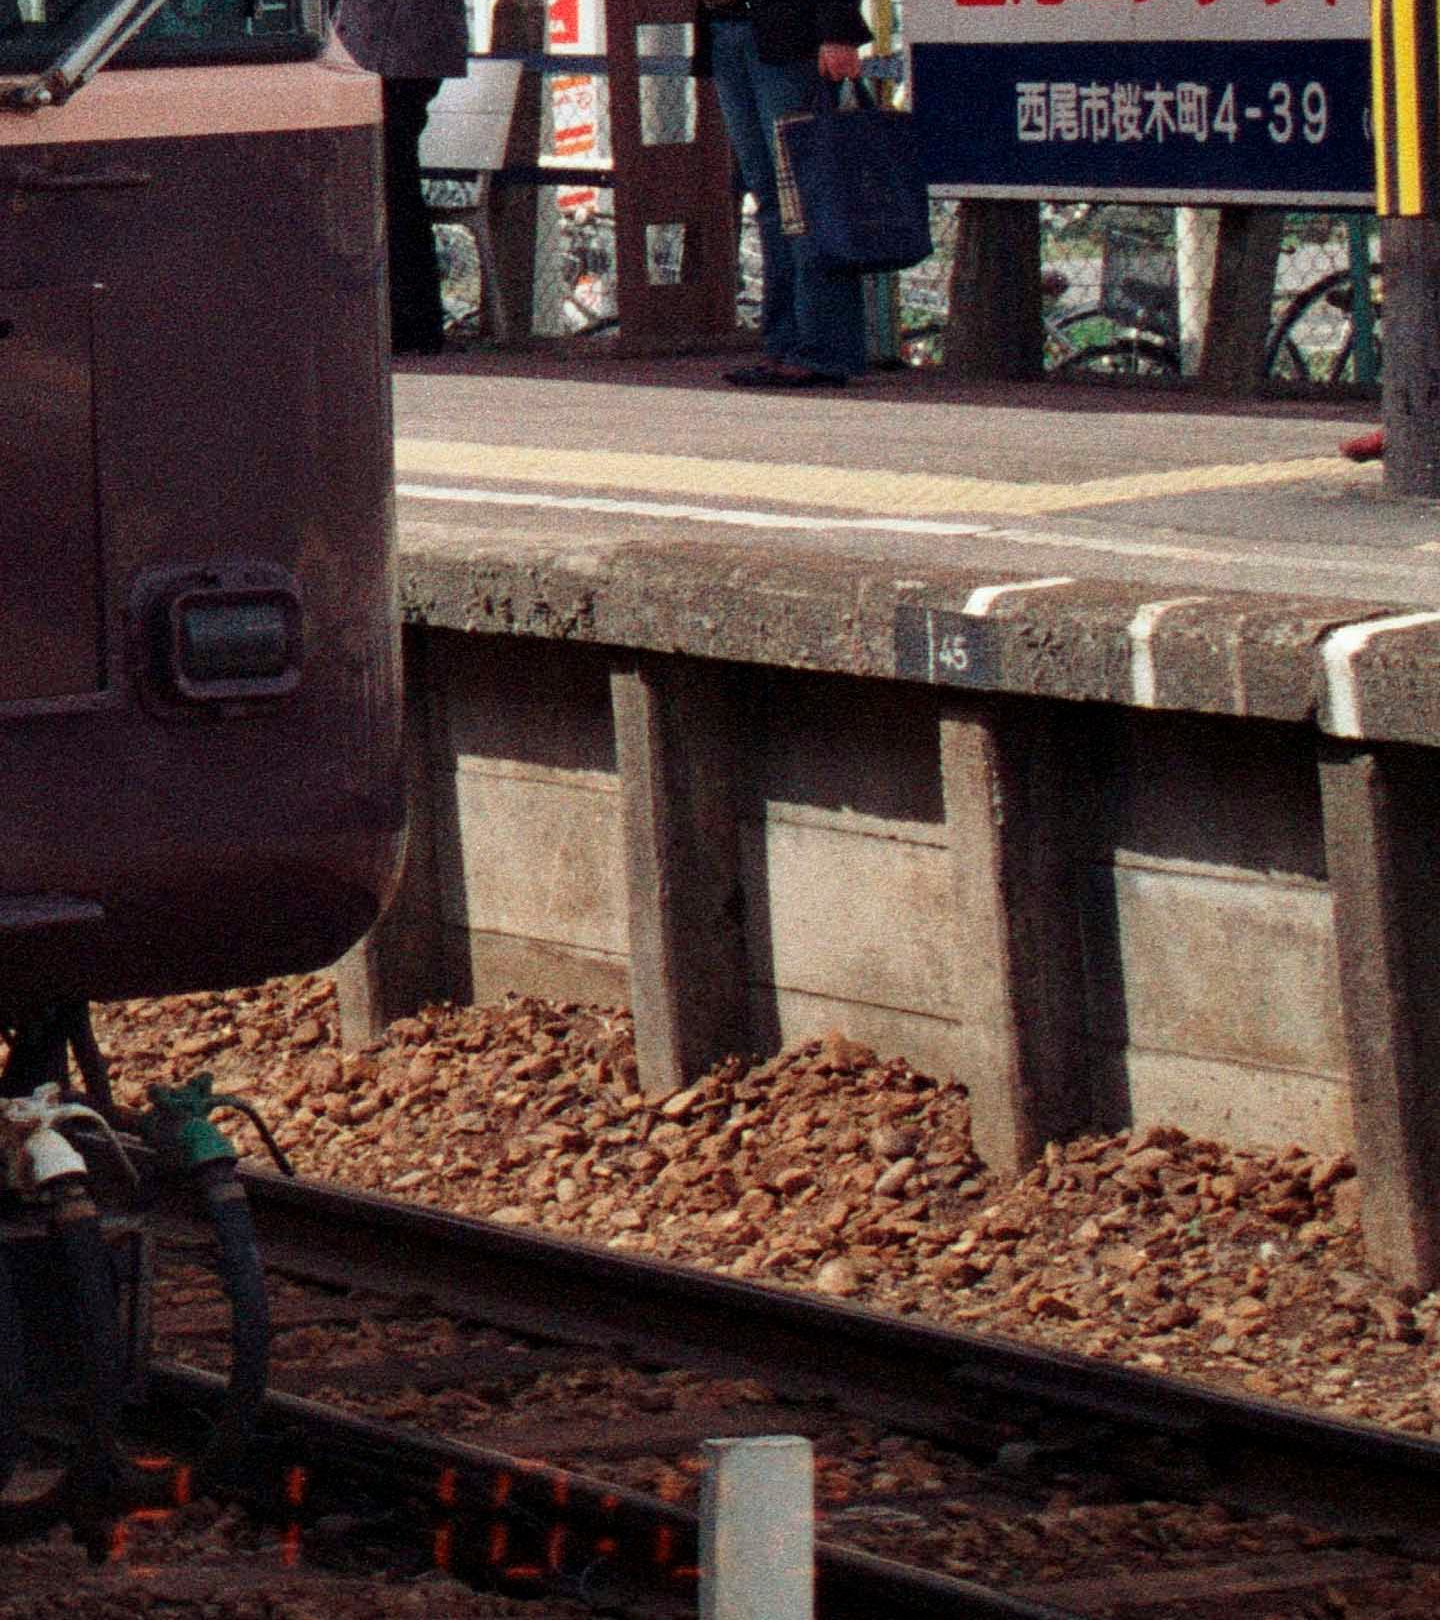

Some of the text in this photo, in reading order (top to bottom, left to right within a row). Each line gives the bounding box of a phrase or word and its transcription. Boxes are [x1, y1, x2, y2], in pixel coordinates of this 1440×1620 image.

[1014, 81, 1329, 145] 西尾市桜木町4-39
